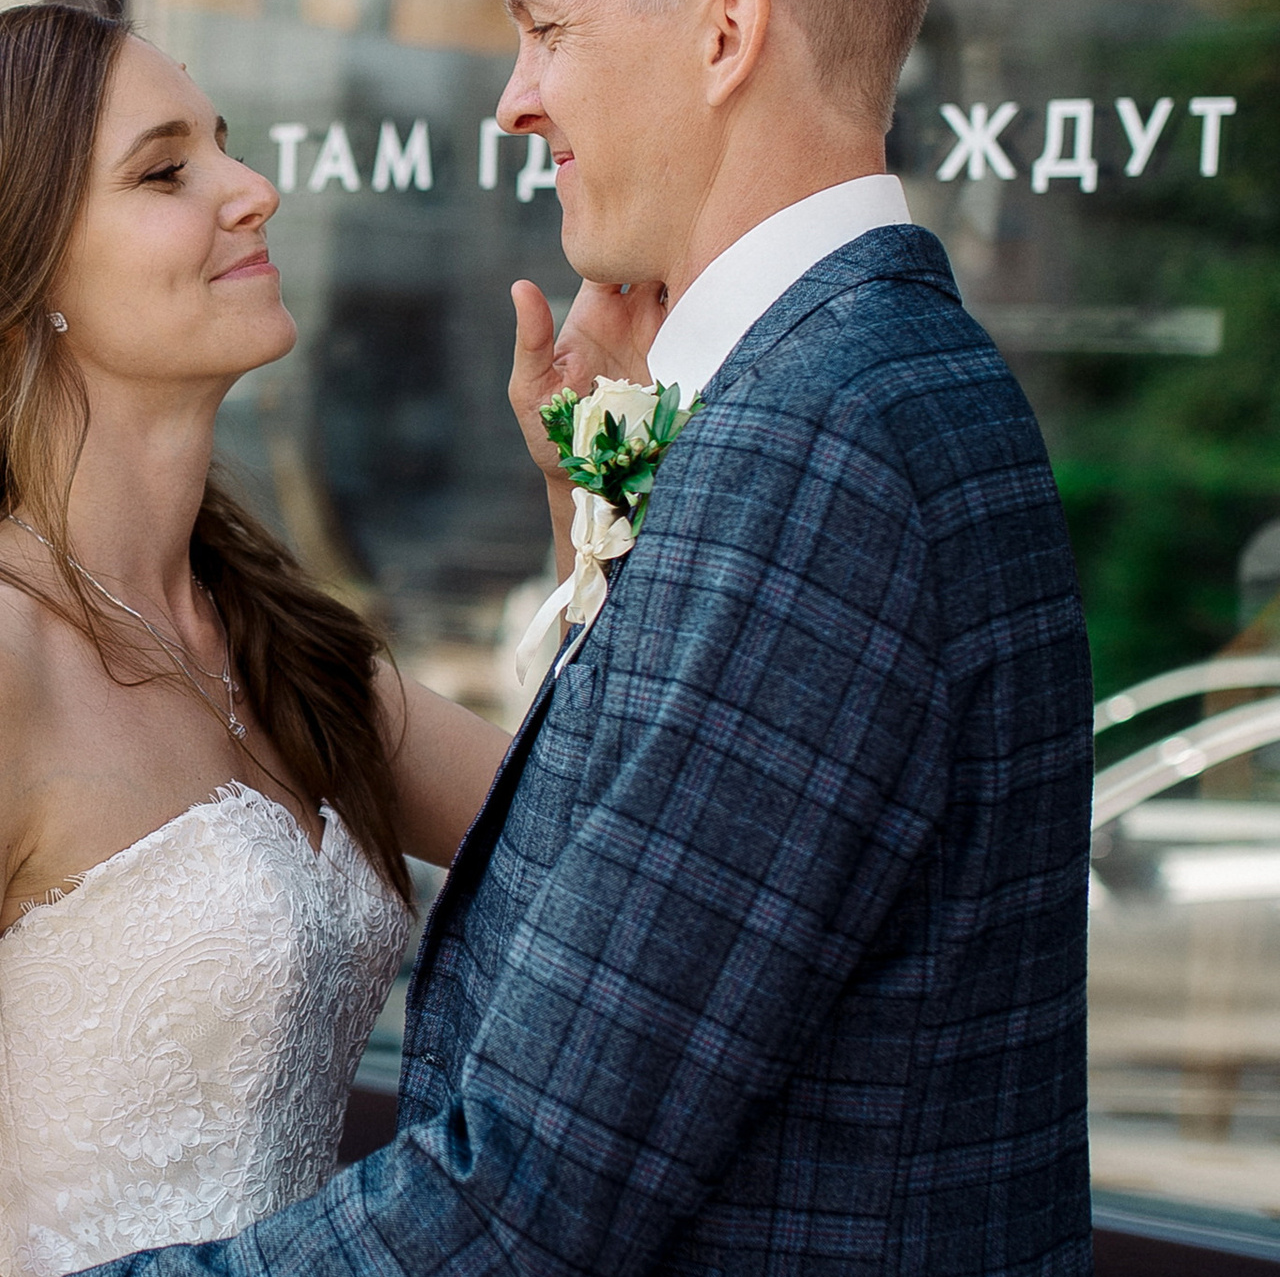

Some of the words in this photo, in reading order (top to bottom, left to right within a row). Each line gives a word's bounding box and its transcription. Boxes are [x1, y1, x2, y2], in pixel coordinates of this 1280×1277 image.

[270, 119, 433, 193] ТАМ
[478, 118, 559, 203] ГД
[935, 96, 1237, 194] ЖДУТ
